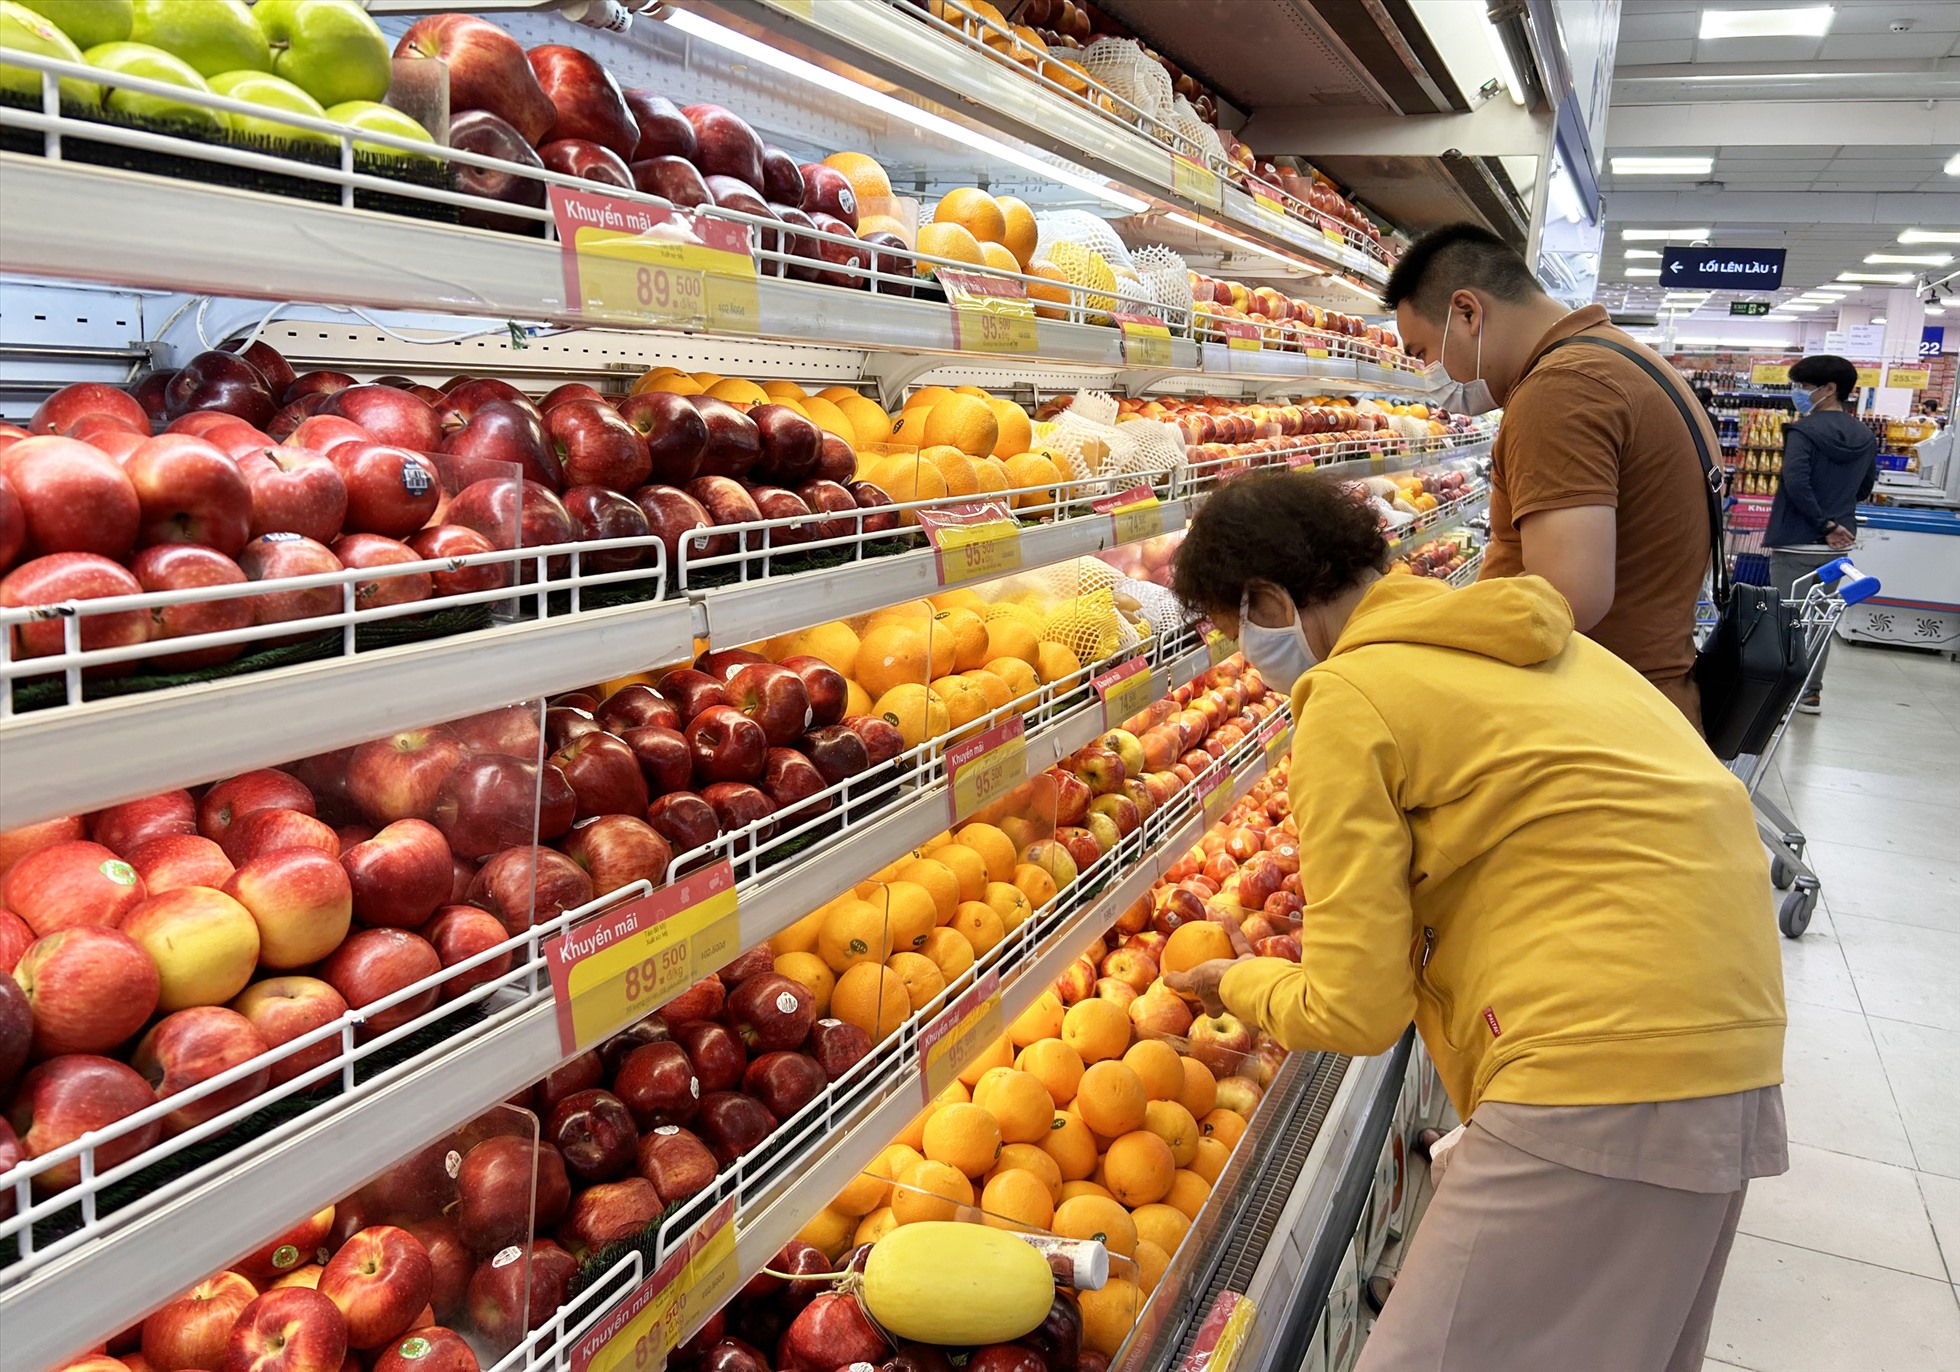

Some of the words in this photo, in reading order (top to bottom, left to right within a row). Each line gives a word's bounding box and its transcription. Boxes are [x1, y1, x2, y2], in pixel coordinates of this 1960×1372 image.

[565, 199, 624, 229] Khuyến
[1699, 260, 1718, 272] LỐI
[1720, 262, 1743, 273] LÊN
[1745, 261, 1770, 274] LẦU
[1772, 265, 1778, 274] 1
[676, 277, 701, 298] 500
[1919, 342, 1940, 355] 22
[951, 745, 974, 767] Khuyến
[973, 740, 985, 756] mãi
[559, 924, 613, 963] Khuyến
[615, 913, 639, 943] mãi
[662, 943, 687, 970] 500
[582, 1309, 629, 1361] Khuyến
[632, 1284, 654, 1315] mãi
